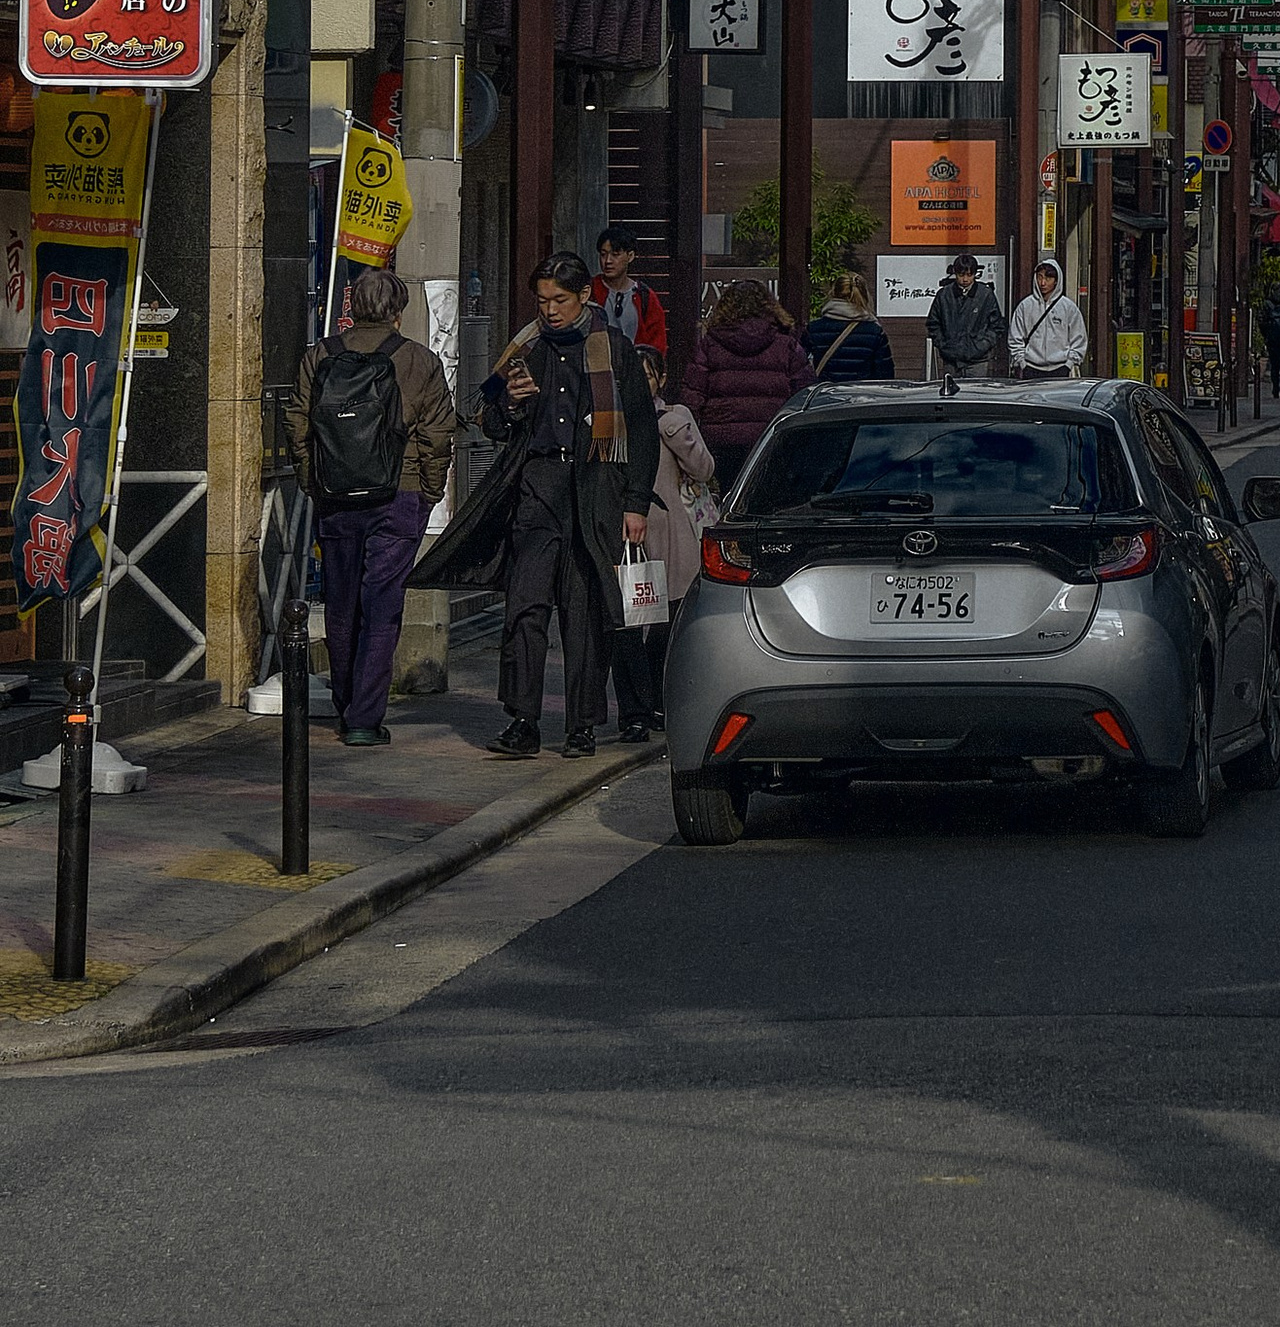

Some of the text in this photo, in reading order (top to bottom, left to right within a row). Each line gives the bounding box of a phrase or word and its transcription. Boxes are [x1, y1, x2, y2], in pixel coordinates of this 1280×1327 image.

[72, 30, 184, 65] アバンチュール
[1204, 158, 1229, 170] 自動車
[904, 186, 981, 198] APA HOTEL
[344, 188, 403, 225] 猫外卖
[344, 213, 397, 234] RYPANDA
[904, 222, 982, 233] www.apahotel.com
[634, 582, 655, 597] 551
[631, 595, 660, 606] HORAI
[876, 592, 969, 619] ひ 74-56
